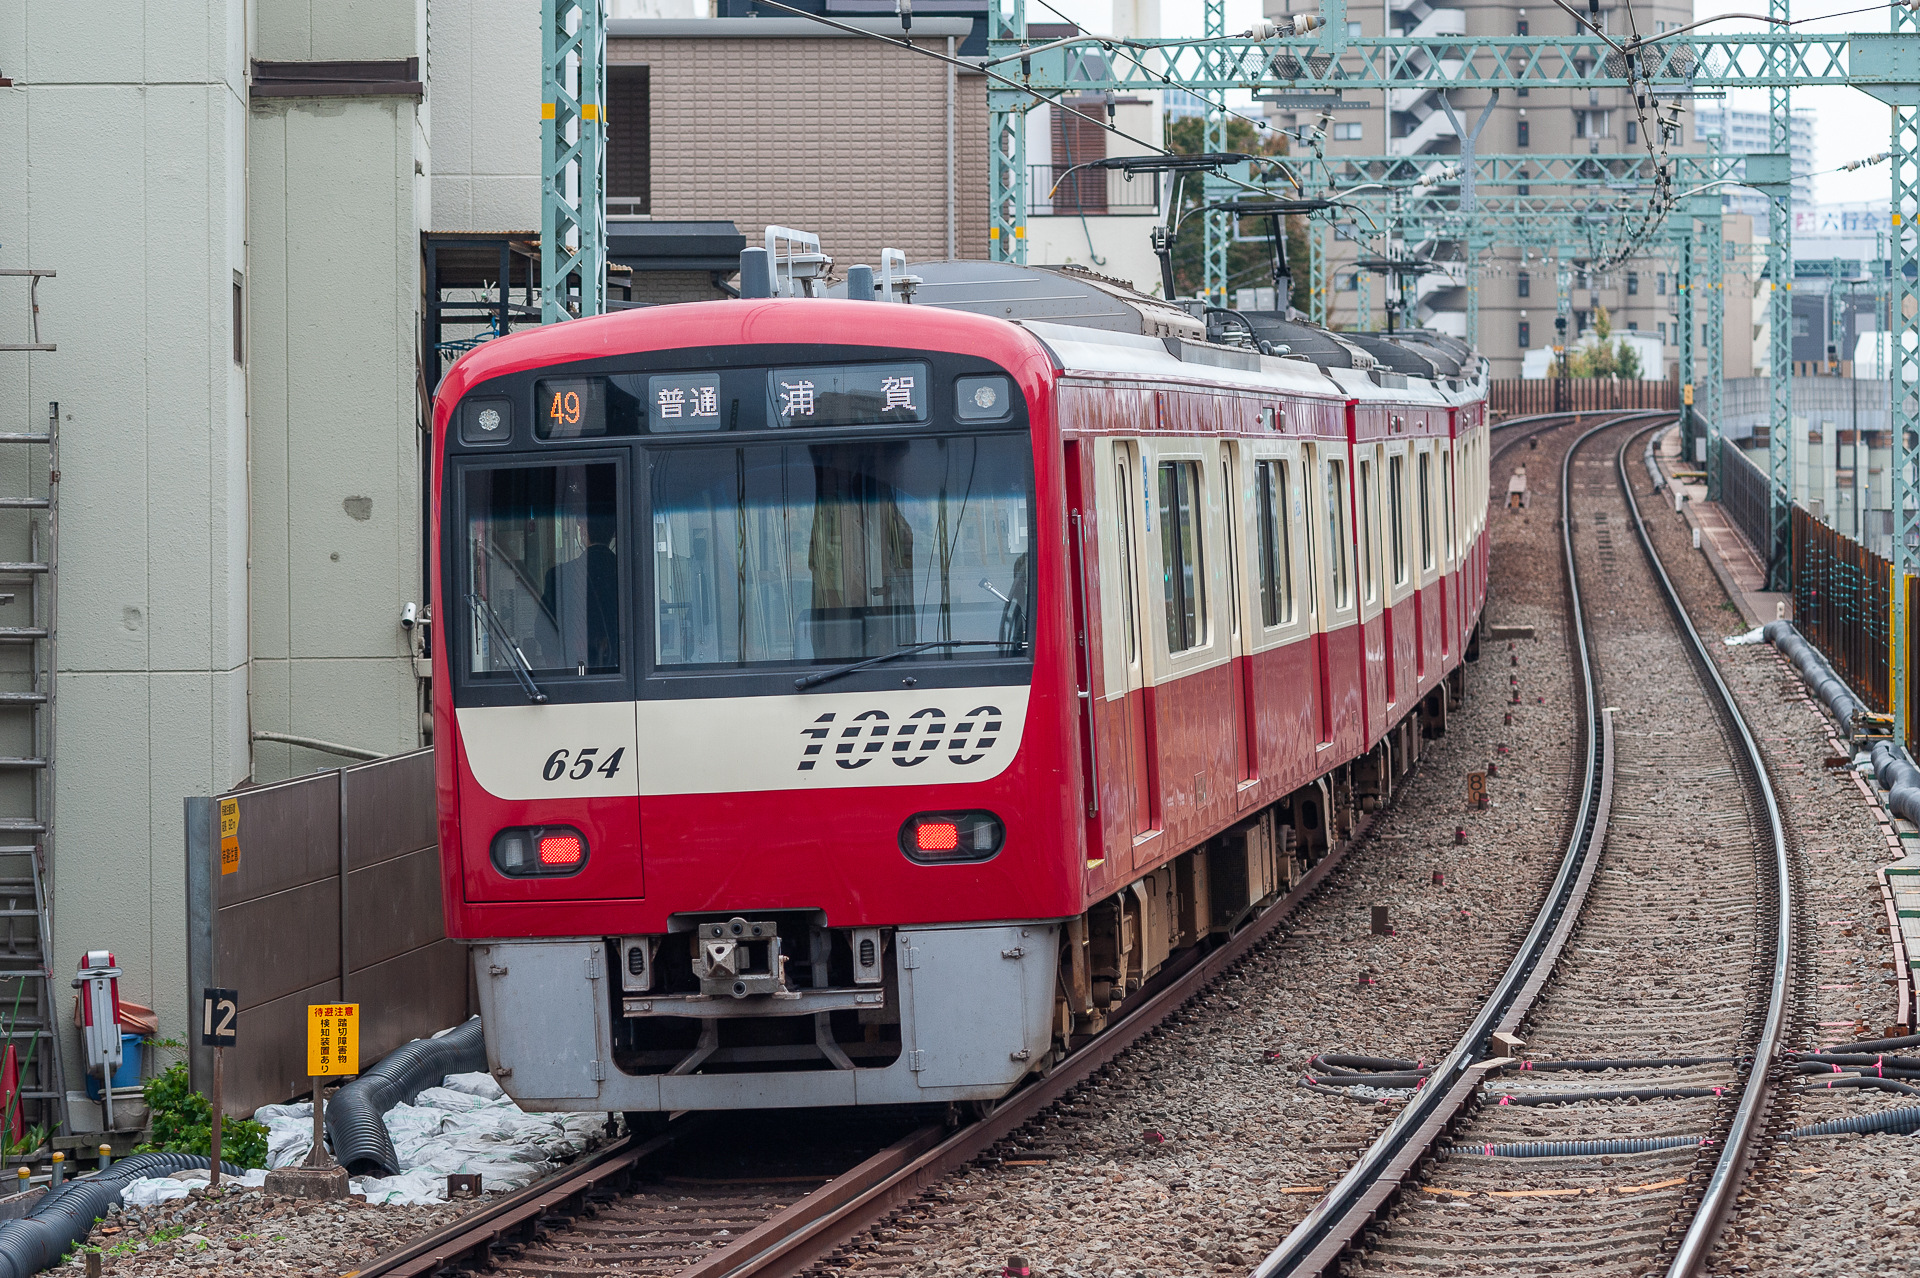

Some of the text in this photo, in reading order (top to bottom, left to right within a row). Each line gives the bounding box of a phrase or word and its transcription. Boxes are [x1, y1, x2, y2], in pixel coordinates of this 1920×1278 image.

[550, 391, 580, 424] 49
[657, 386, 719, 418] 普通
[780, 376, 917, 417] 浦賀
[797, 705, 1003, 770] 1000
[542, 746, 626, 781] 654
[204, 998, 236, 1037] 12
[314, 1006, 354, 1018] 待避注意
[320, 1018, 331, 1074] 検知装置あり
[337, 1018, 348, 1064] 踏切障害物
